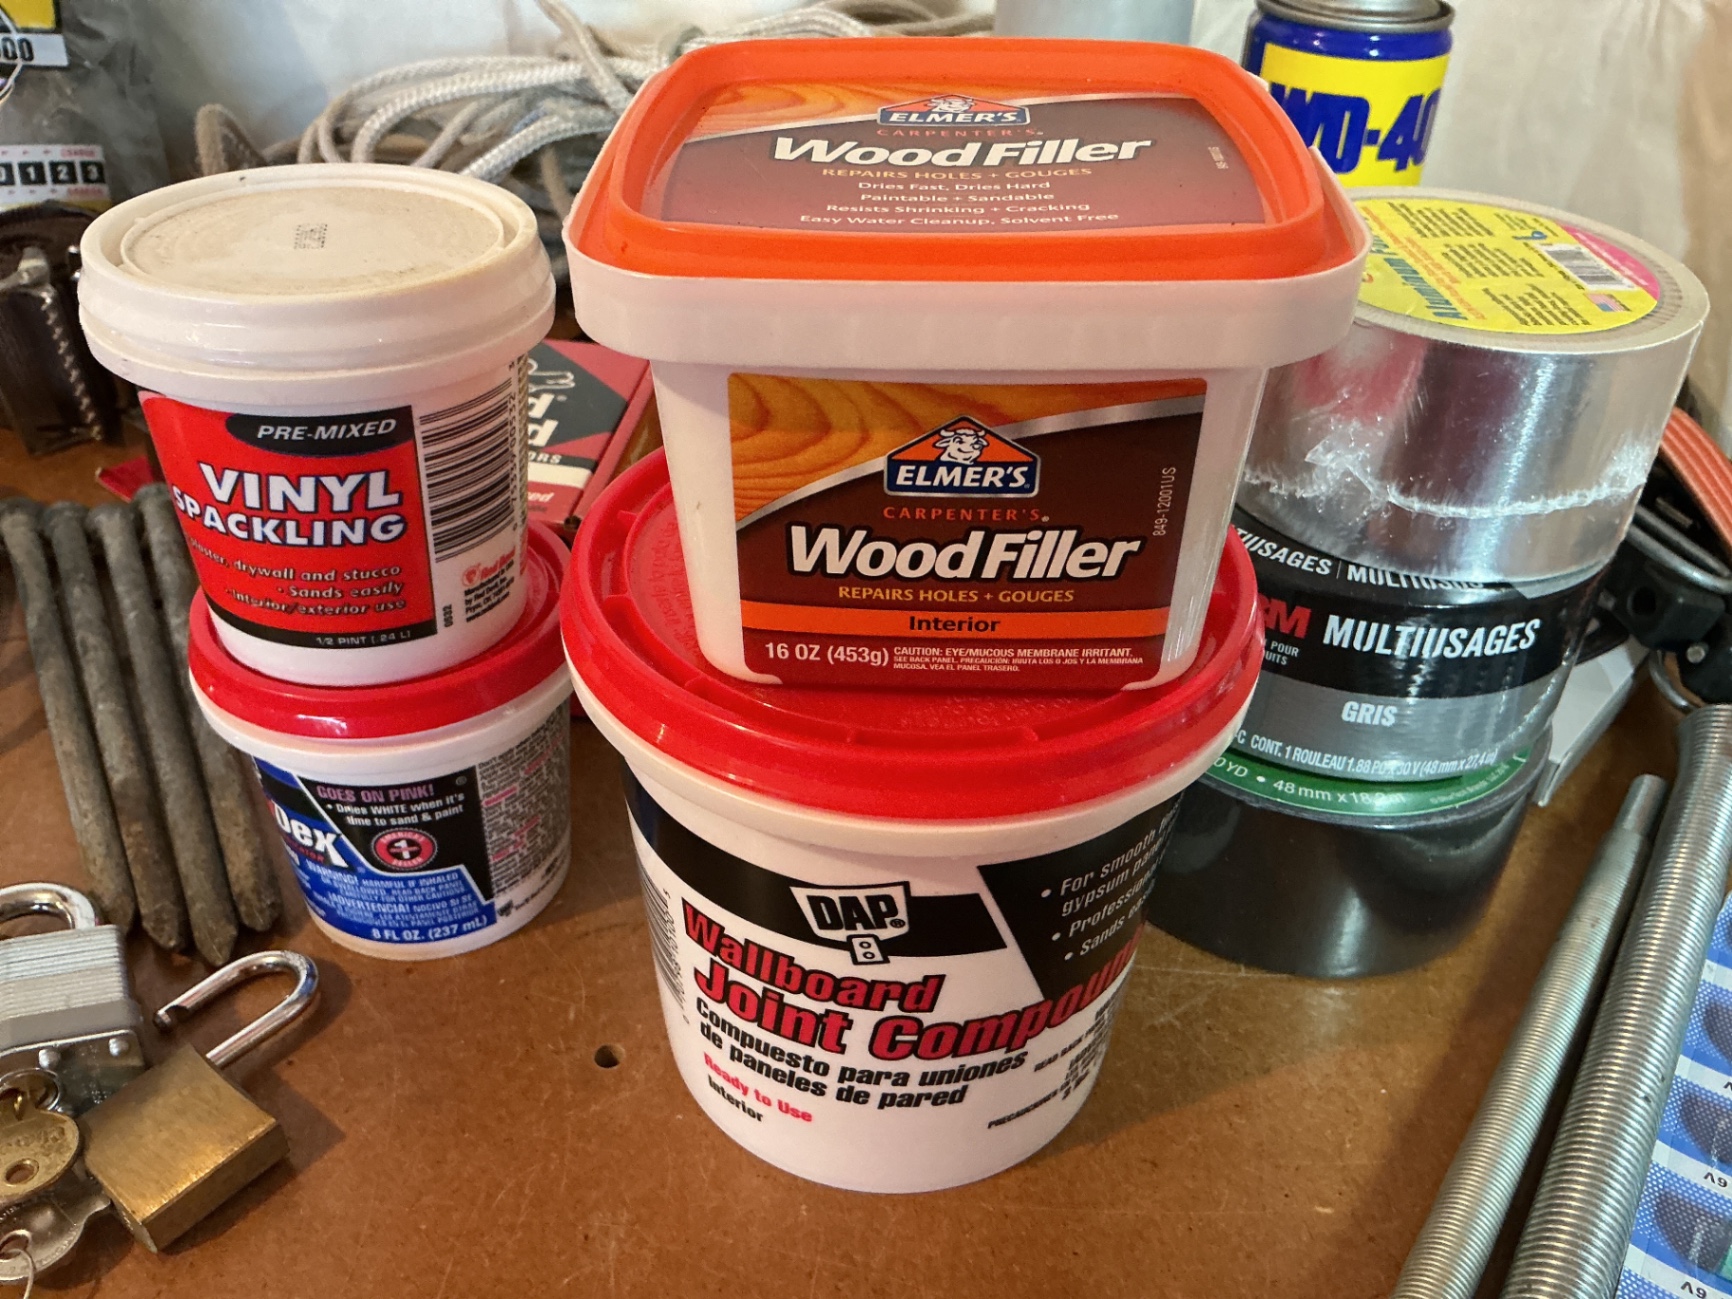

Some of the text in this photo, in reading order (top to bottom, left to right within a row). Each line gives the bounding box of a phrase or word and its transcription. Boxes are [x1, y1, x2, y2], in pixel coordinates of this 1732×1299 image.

[0, 37, 34, 62] 00
[889, 111, 1018, 123] ELMER'S
[1270, 81, 1442, 174] WD-40
[877, 128, 1038, 137] CARPENTER'S
[774, 137, 1152, 166] Wood Filler
[56, 165, 71, 181] 2
[822, 168, 908, 179] REPAIRS
[914, 171, 982, 180] HOLES
[1004, 168, 1093, 179] GOUGES
[858, 181, 1051, 192] Dries Fast, Dries Hard
[860, 193, 948, 202] Paintable
[967, 193, 1055, 202] Sandable
[800, 212, 1119, 227] Easy Water Cleanup, Solvent Free
[827, 204, 890, 213] Resists
[894, 205, 985, 215] Shrinking
[1006, 203, 1091, 214] Cracking
[256, 418, 397, 440] PRE-MIXED
[198, 461, 402, 514] VINYL
[895, 464, 1028, 488] ELMER'S
[883, 506, 1041, 521] CARPENTER'S
[1152, 465, 1177, 537] 849-12001US
[170, 483, 407, 547] SPACKLING
[790, 525, 1141, 580] Wood Filler
[233, 559, 296, 580] drywall
[301, 570, 336, 581] and
[343, 566, 401, 580] stucco
[231, 588, 406, 614] Interior/exterior use
[288, 581, 404, 599] Sands easily
[838, 586, 914, 602] REPAIRS
[919, 589, 979, 603] HOLES
[1000, 589, 1075, 603] GOUGES
[908, 615, 1001, 633] Interior
[338, 636, 367, 646] PINT
[1270, 640, 1300, 658] POUR
[1322, 614, 1541, 661] MULTIUSAGES
[765, 642, 889, 667] 16 OZ (453g)
[893, 646, 1133, 658] CAUTION: EYE/MUCOUS MEMBRANE IRRITANT.
[1262, 649, 1289, 667] UITS
[1341, 701, 1398, 727] GRIS
[1250, 734, 1284, 758] CONT.
[1284, 745, 1293, 760] 1
[1292, 747, 1348, 771] ROULEAU
[1347, 757, 1371, 774] 1.88
[1412, 759, 1421, 774] V
[1420, 759, 1440, 777] (48
[1439, 759, 1460, 774] mm
[316, 783, 434, 802] GOES ON PINK!
[1226, 761, 1249, 777] YD
[1273, 779, 1295, 794] 48
[1298, 786, 1331, 801] mm
[1337, 792, 1348, 803] x
[336, 792, 465, 815] Dries WHITE when it's
[345, 803, 464, 827] time to sand & paint
[1061, 829, 1157, 896] For smooth
[362, 878, 405, 889] HARMFUL
[1061, 868, 1130, 918] gypsum
[806, 894, 899, 932] DAP
[371, 914, 488, 941] 8 FL OZ. (237 mL)
[1079, 915, 1126, 956] Sands
[681, 897, 947, 1013] Wallboard
[694, 957, 853, 1055] Joint
[868, 917, 1147, 1061] Compoun
[696, 997, 1029, 1088] Compuesto para uniones
[700, 1020, 969, 1110] de paneles de pared
[703, 1051, 813, 1123] Ready to Use
[707, 1074, 764, 1122] Interior
